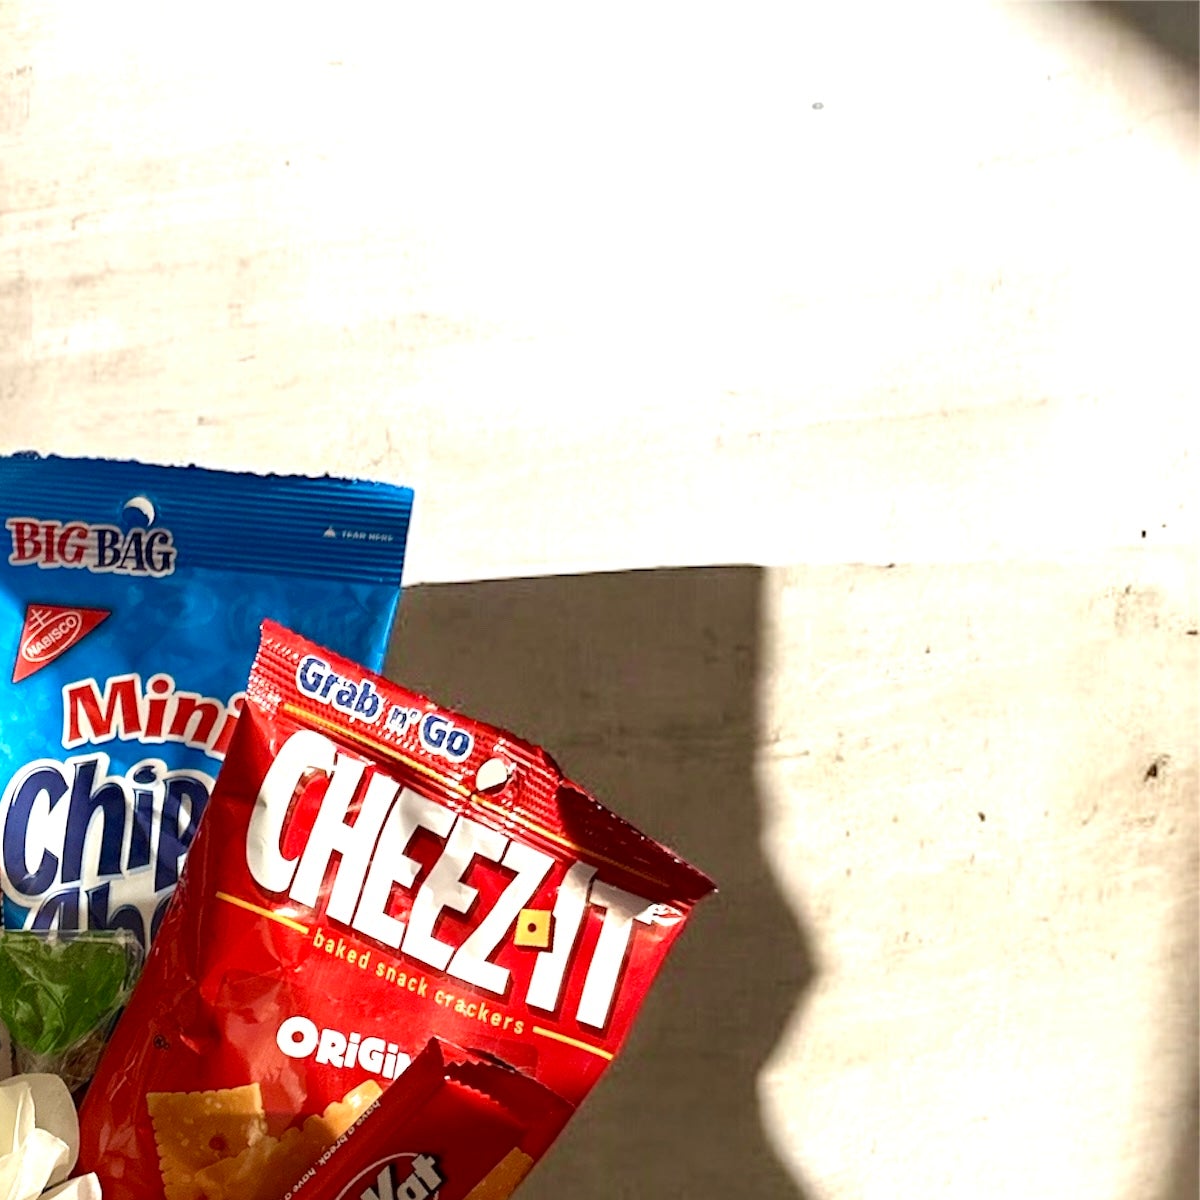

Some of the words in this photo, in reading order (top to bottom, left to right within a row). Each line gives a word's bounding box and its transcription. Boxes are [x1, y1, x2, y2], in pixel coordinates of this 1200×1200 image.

[7, 519, 90, 566] BIG
[92, 527, 175, 574] BAG
[26, 616, 77, 657] NABISCO
[67, 679, 244, 754] Mini
[297, 656, 381, 720] Grab
[421, 713, 471, 758] Go
[313, 929, 372, 970] baked
[376, 962, 428, 999] snack
[434, 988, 524, 1035] crackers
[284, 1193, 292, 1200] a
[293, 1168, 316, 1192] have
